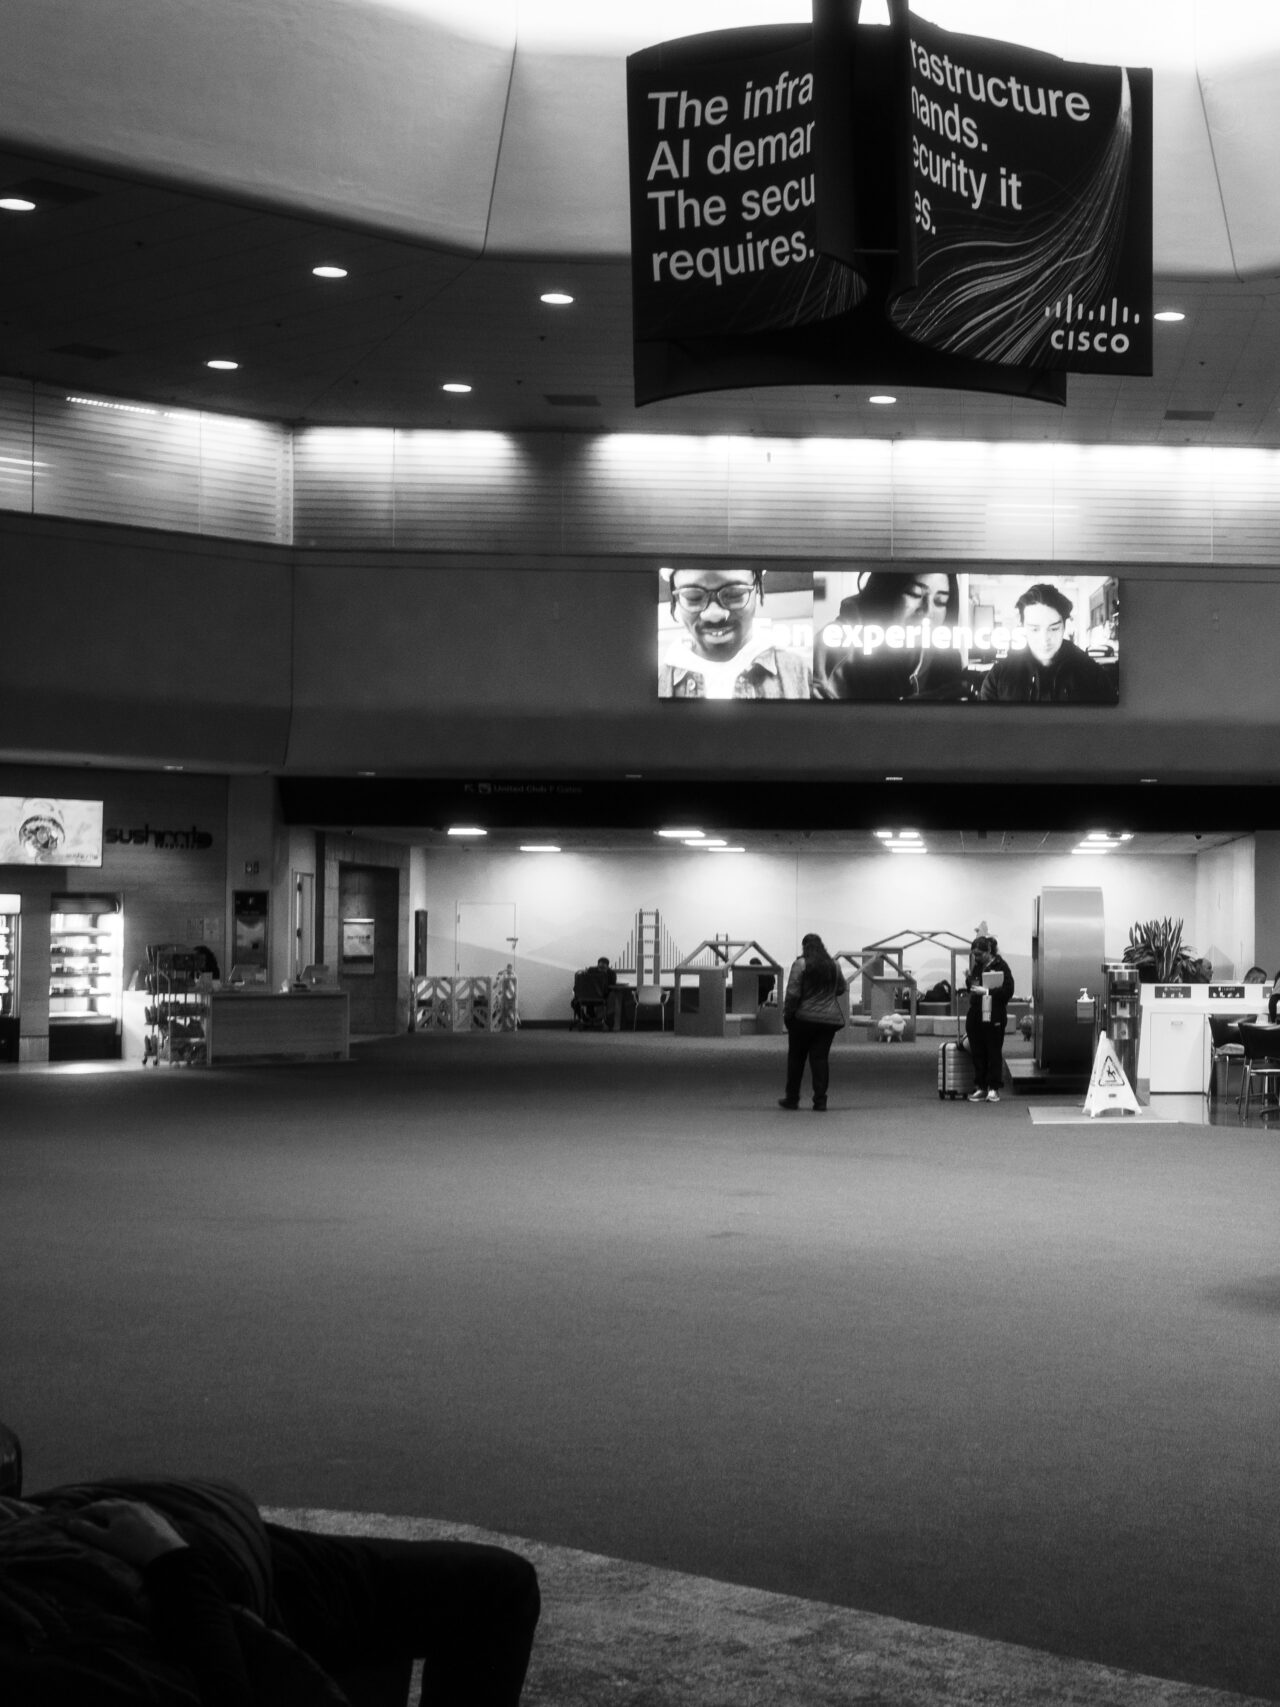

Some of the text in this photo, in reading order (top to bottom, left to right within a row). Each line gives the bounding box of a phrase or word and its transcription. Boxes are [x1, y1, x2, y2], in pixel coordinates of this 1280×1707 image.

[647, 70, 814, 130] The infra
[910, 38, 1091, 122] rastructure
[646, 138, 690, 181] AI
[647, 173, 815, 231] The secu
[1000, 166, 1023, 211] it
[652, 231, 815, 286] requires.
[822, 617, 1027, 655] experiences
